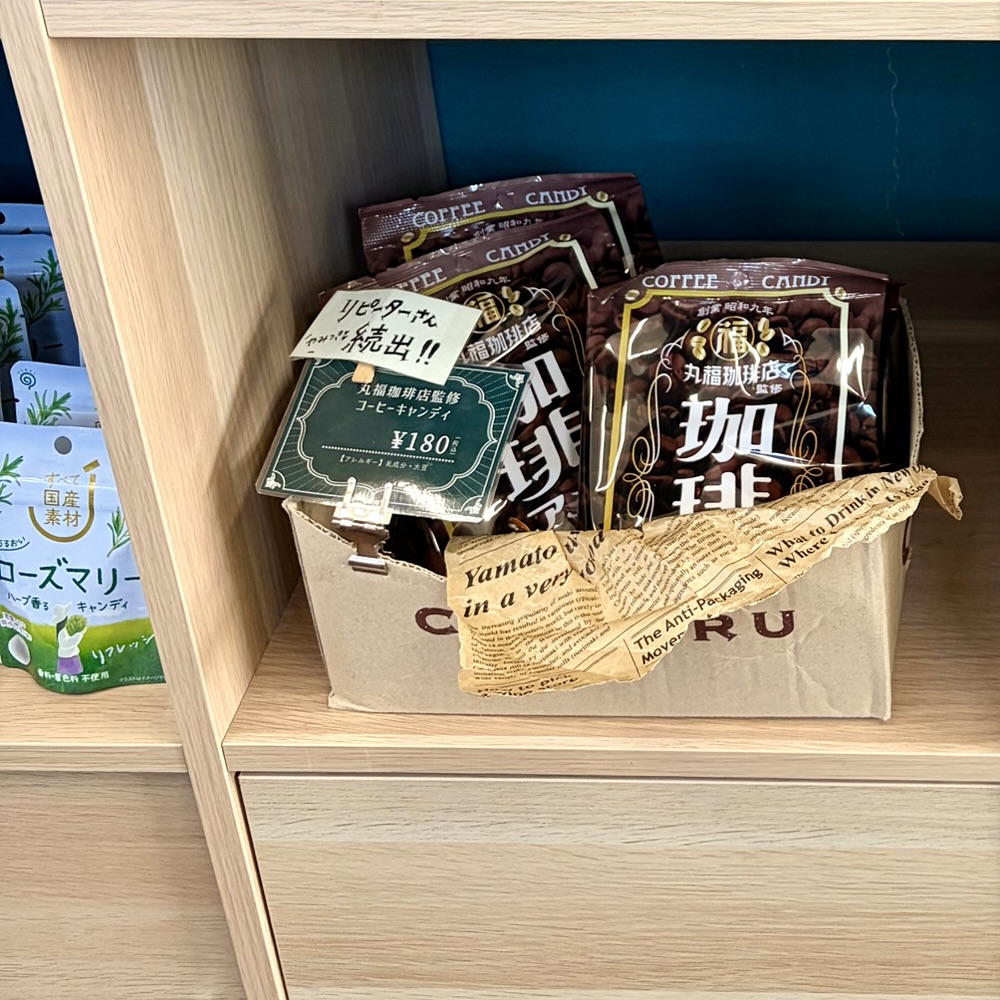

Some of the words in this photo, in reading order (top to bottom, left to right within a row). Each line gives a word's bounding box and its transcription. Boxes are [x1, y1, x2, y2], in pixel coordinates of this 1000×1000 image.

[337, 298, 439, 328] リピーターさん
[717, 321, 748, 353] 福
[357, 383, 461, 405] 丸福珈琲店監修
[355, 400, 451, 421] コーヒーキャンディ
[391, 430, 450, 455] ¥180
[44, 472, 80, 488] すべて
[44, 490, 81, 508] 国産
[44, 508, 81, 527] 素材
[765, 535, 808, 558] What
[809, 525, 826, 538] to
[824, 494, 866, 528] Drink
[867, 484, 881, 499] in
[880, 468, 915, 491] New
[777, 536, 830, 570] Where
[464, 544, 558, 590] Yamato
[77, 598, 128, 613] キャンディ
[463, 599, 490, 618] in
[500, 591, 516, 609] a
[525, 568, 573, 598] very
[633, 628, 662, 651] The
[664, 567, 764, 632] Anti-Packaging
